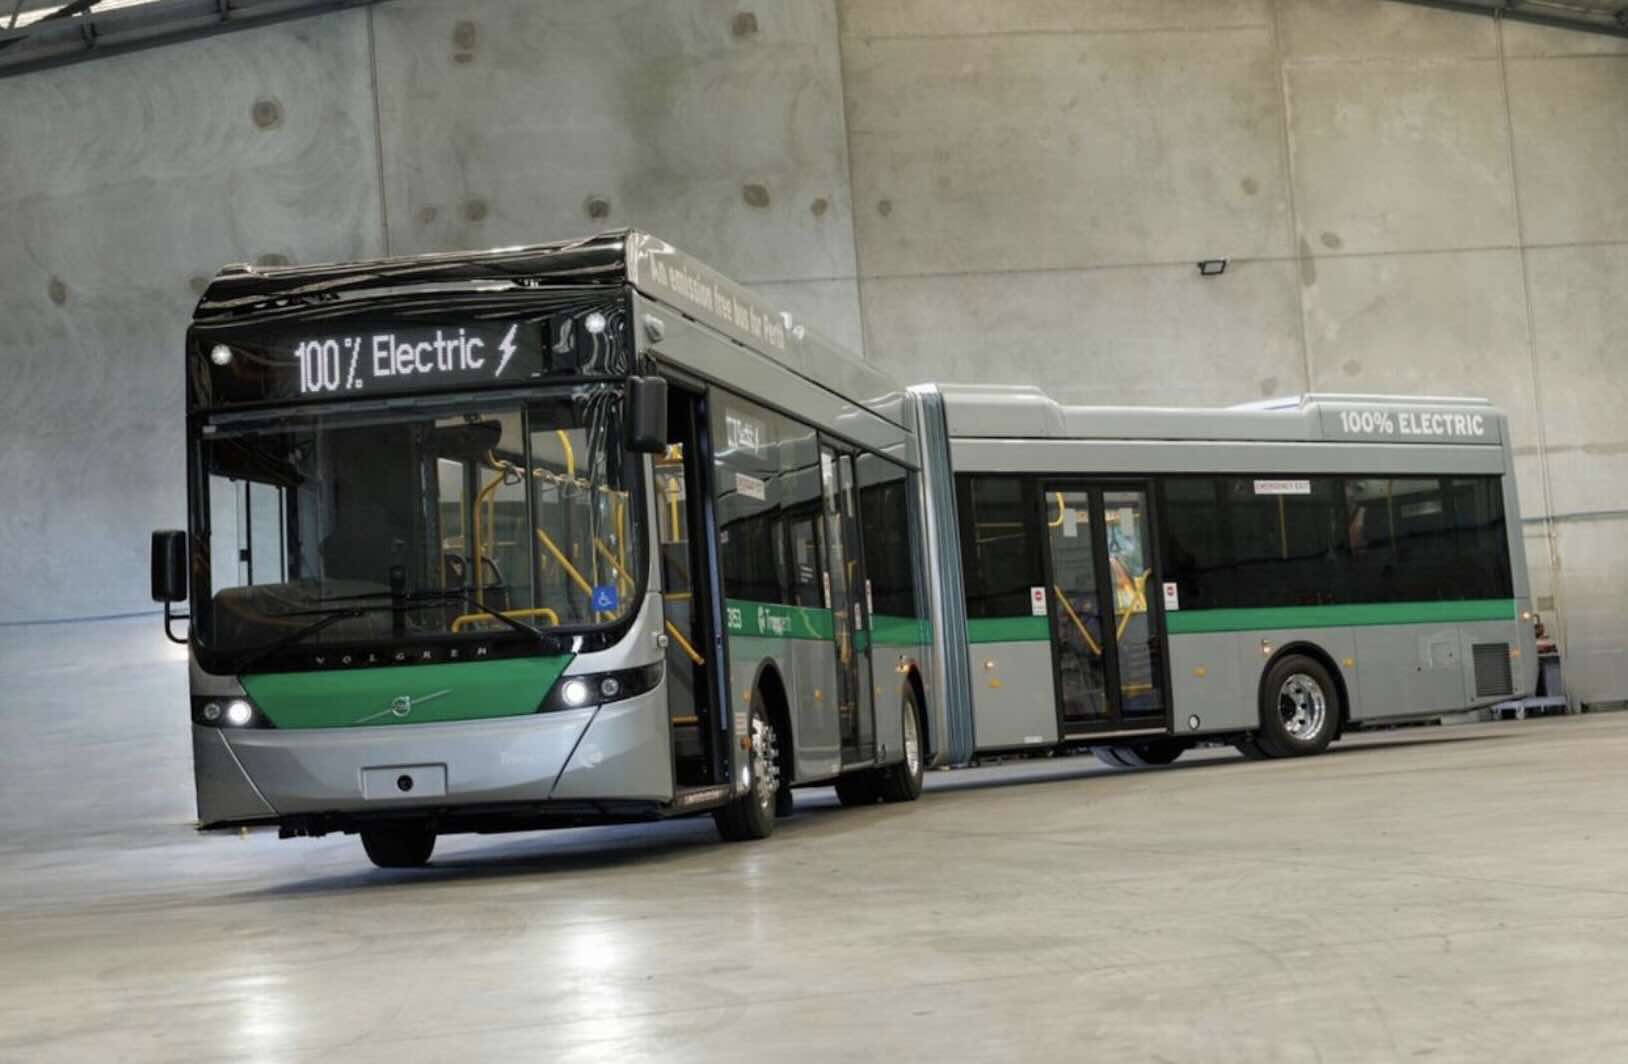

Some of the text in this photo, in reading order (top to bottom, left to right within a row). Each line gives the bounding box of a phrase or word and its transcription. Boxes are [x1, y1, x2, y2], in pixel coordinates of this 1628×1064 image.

[713, 284, 733, 323] free
[733, 295, 749, 332] bus
[294, 328, 485, 393] 100% Electric
[1340, 410, 1485, 436] 100% ELECTRIC
